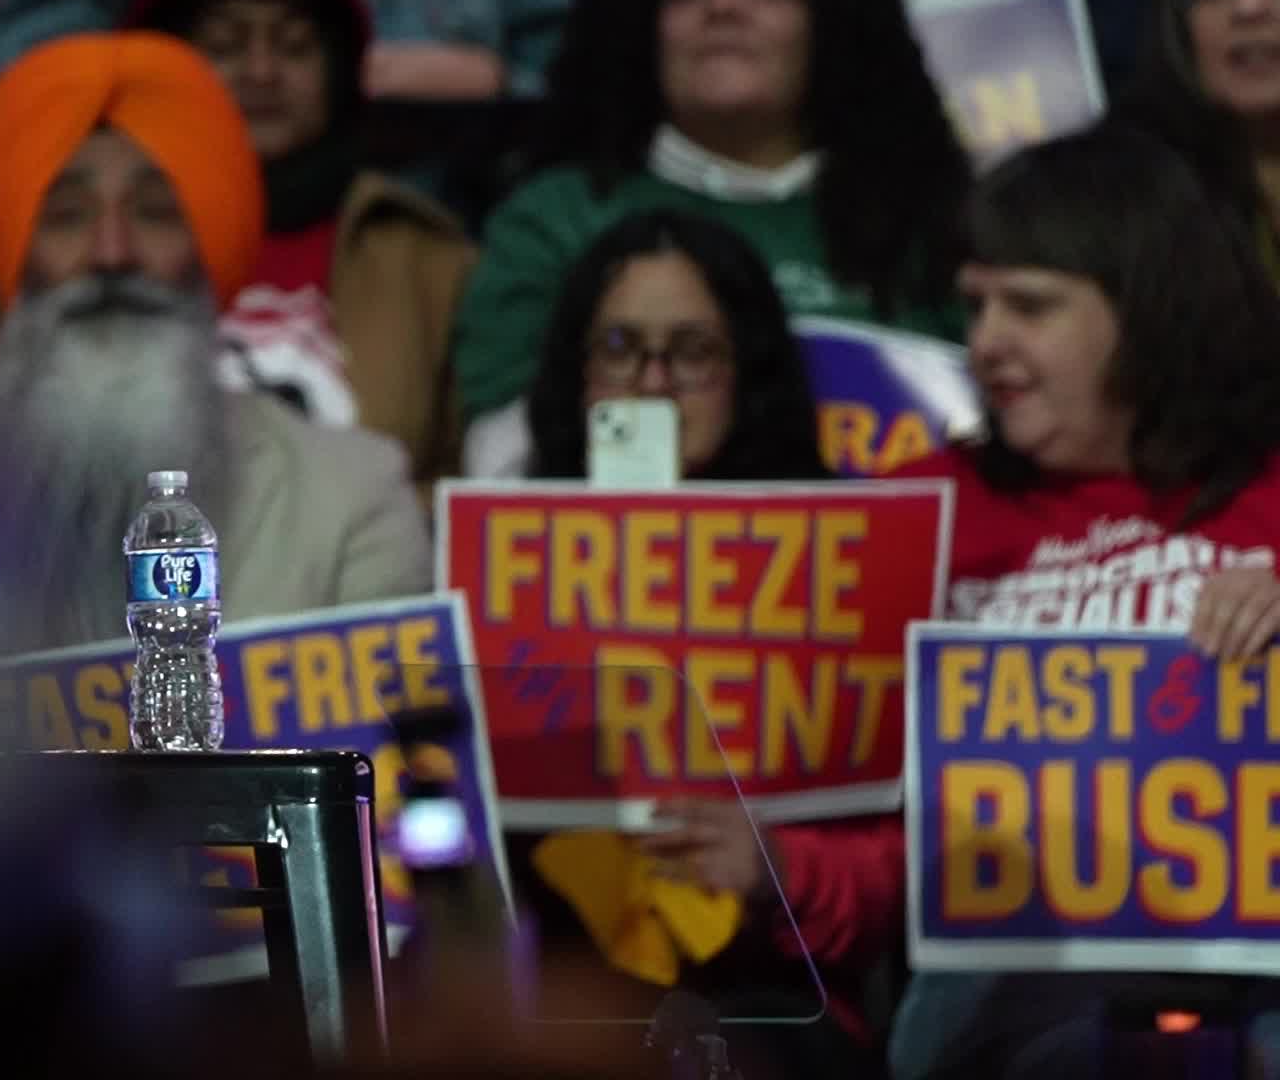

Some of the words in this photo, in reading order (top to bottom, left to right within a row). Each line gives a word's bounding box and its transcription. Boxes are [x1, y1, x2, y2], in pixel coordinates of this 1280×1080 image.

[161, 554, 196, 568] Pure
[164, 567, 193, 585] Life
[484, 508, 869, 639] FREEZE
[240, 618, 452, 742] FREE
[594, 640, 906, 783] RENT
[936, 645, 1147, 745] FAST
[1148, 652, 1203, 735] &
